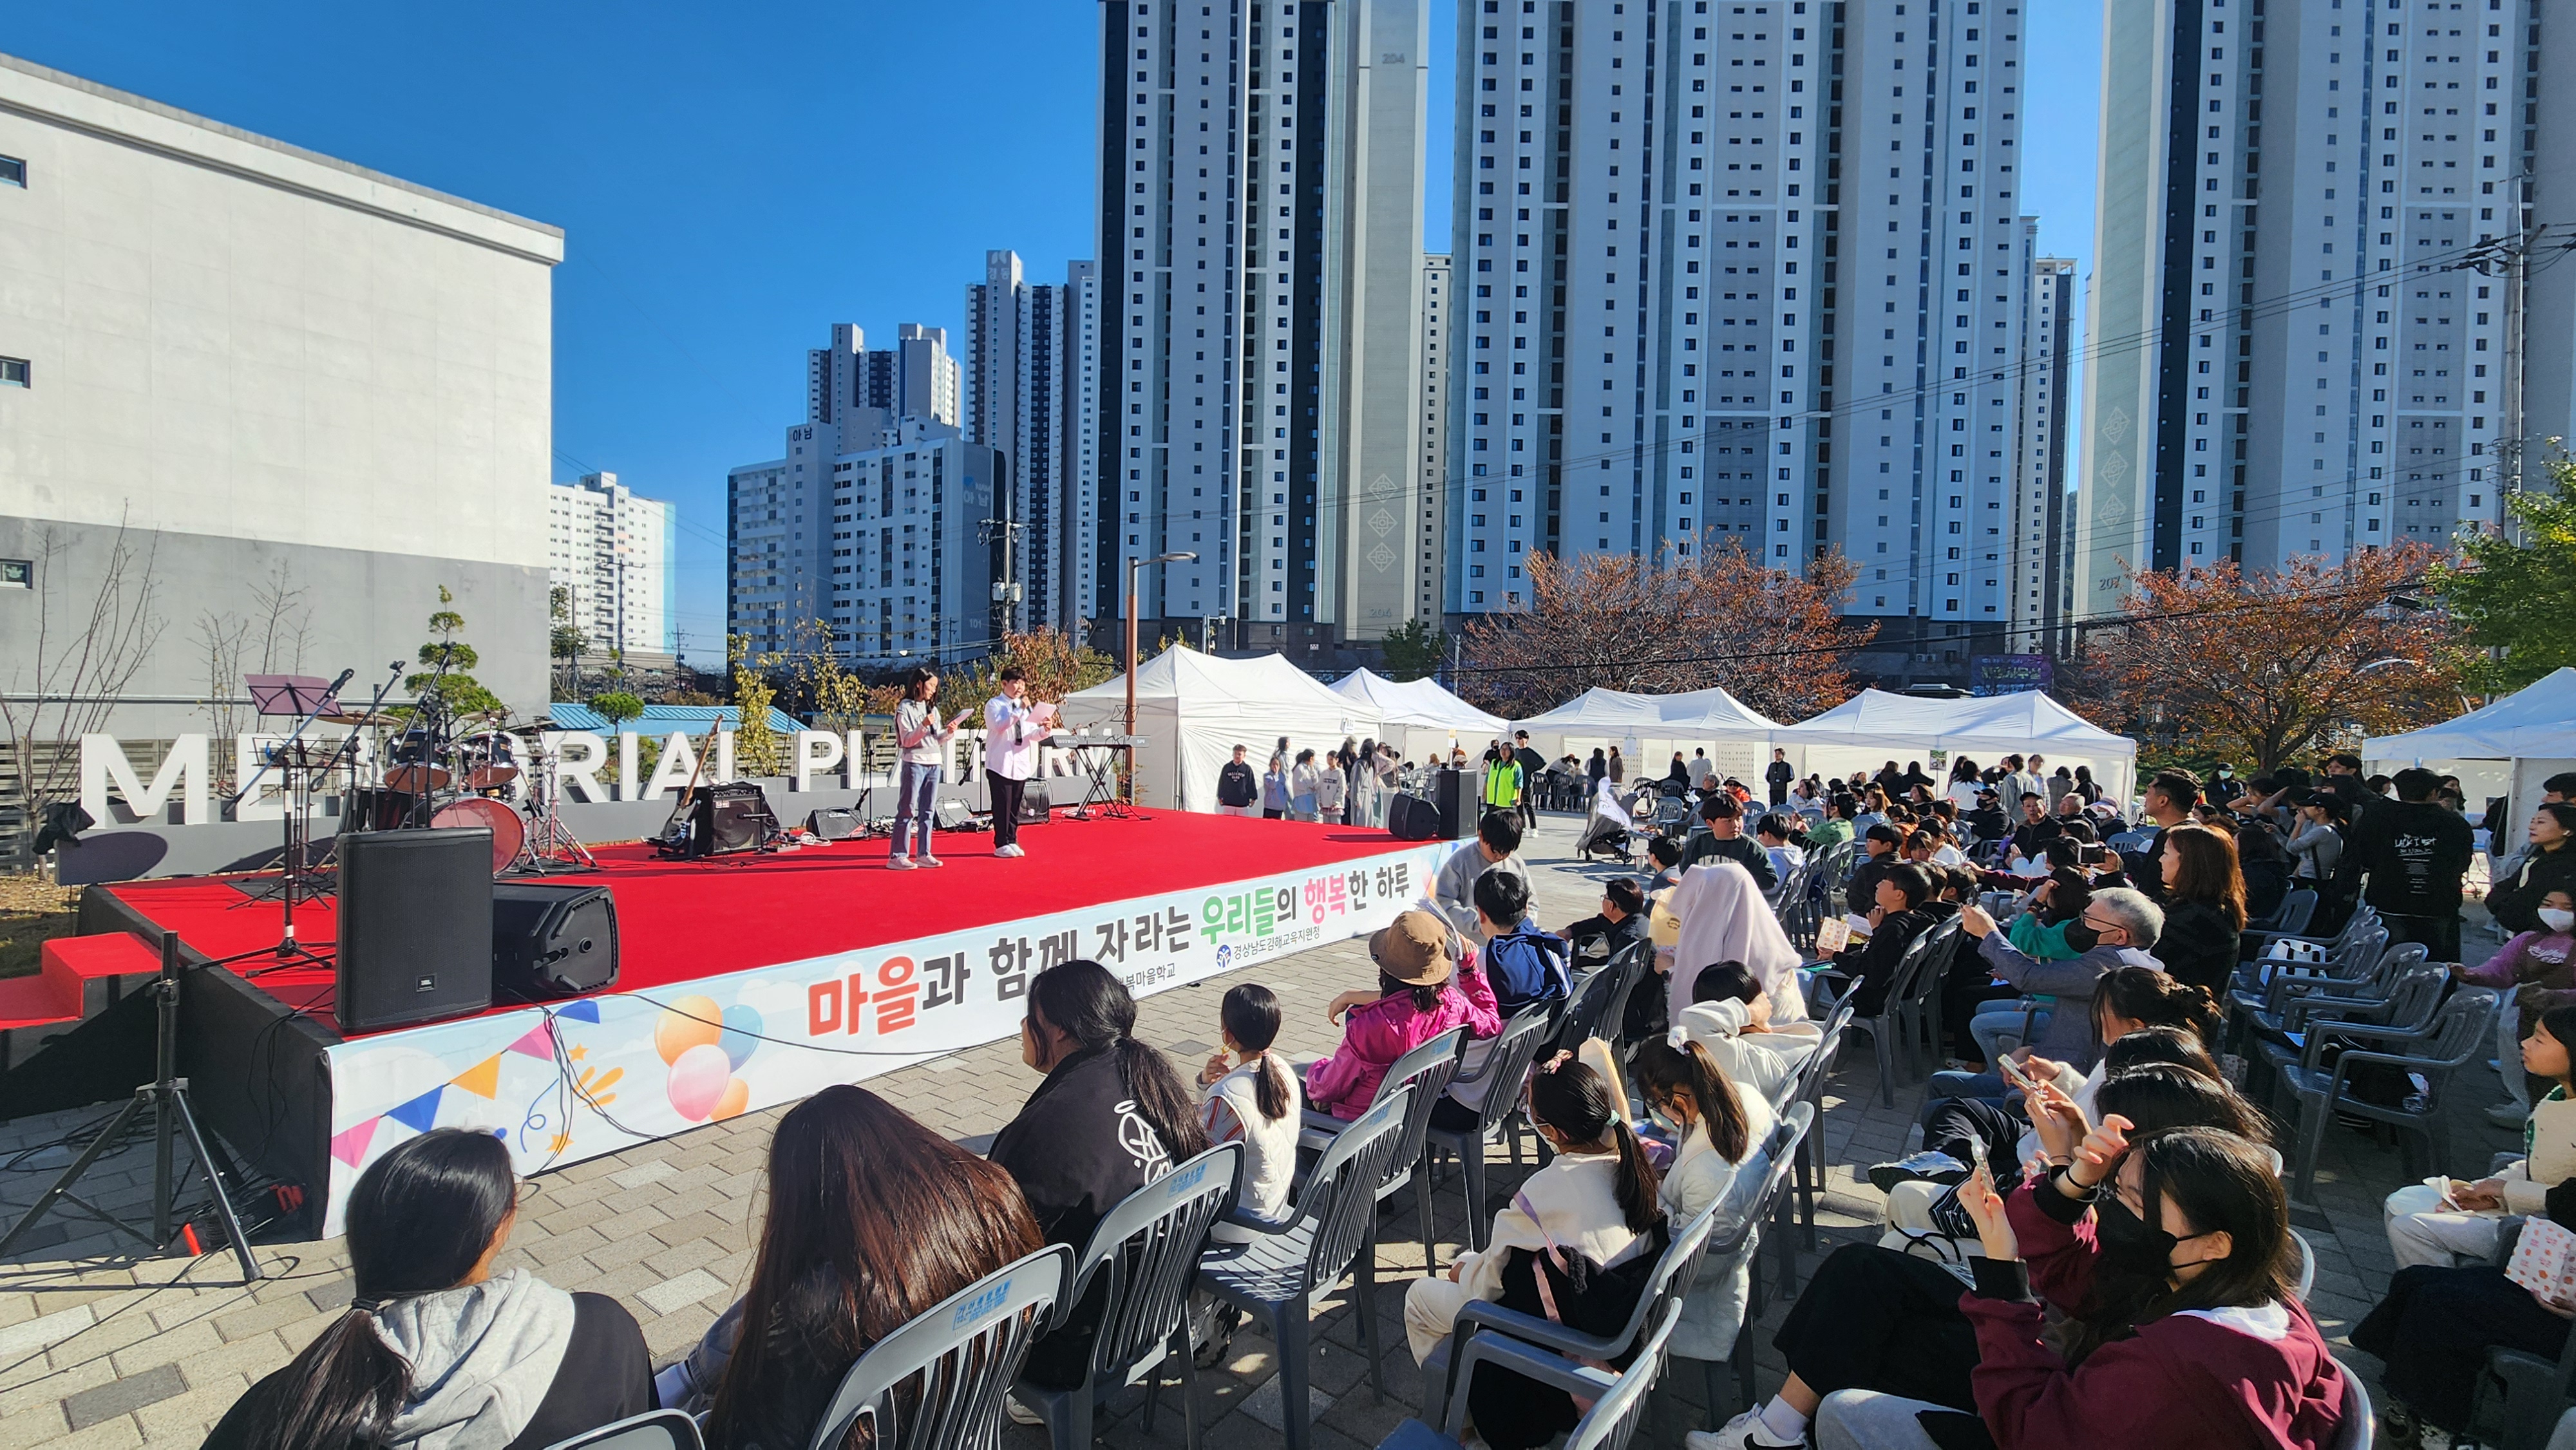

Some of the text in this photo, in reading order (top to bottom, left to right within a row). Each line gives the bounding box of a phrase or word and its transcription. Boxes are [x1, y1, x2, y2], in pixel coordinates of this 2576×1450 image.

[1382, 53, 1405, 64] 204
[793, 426, 813, 442] 아남
[963, 490, 989, 507] 아남
[1369, 608, 1391, 618] 204
[969, 619, 981, 628] 101
[808, 952, 971, 1037] 마을과
[1095, 905, 1192, 964] 자라는
[1200, 886, 1297, 945] 우리들의
[1304, 869, 1369, 925] 행복한
[1376, 862, 1409, 899] 하루
[1233, 925, 1320, 960] 경상남도김해교육지원청
[1120, 962, 1176, 991] 복마을학교
